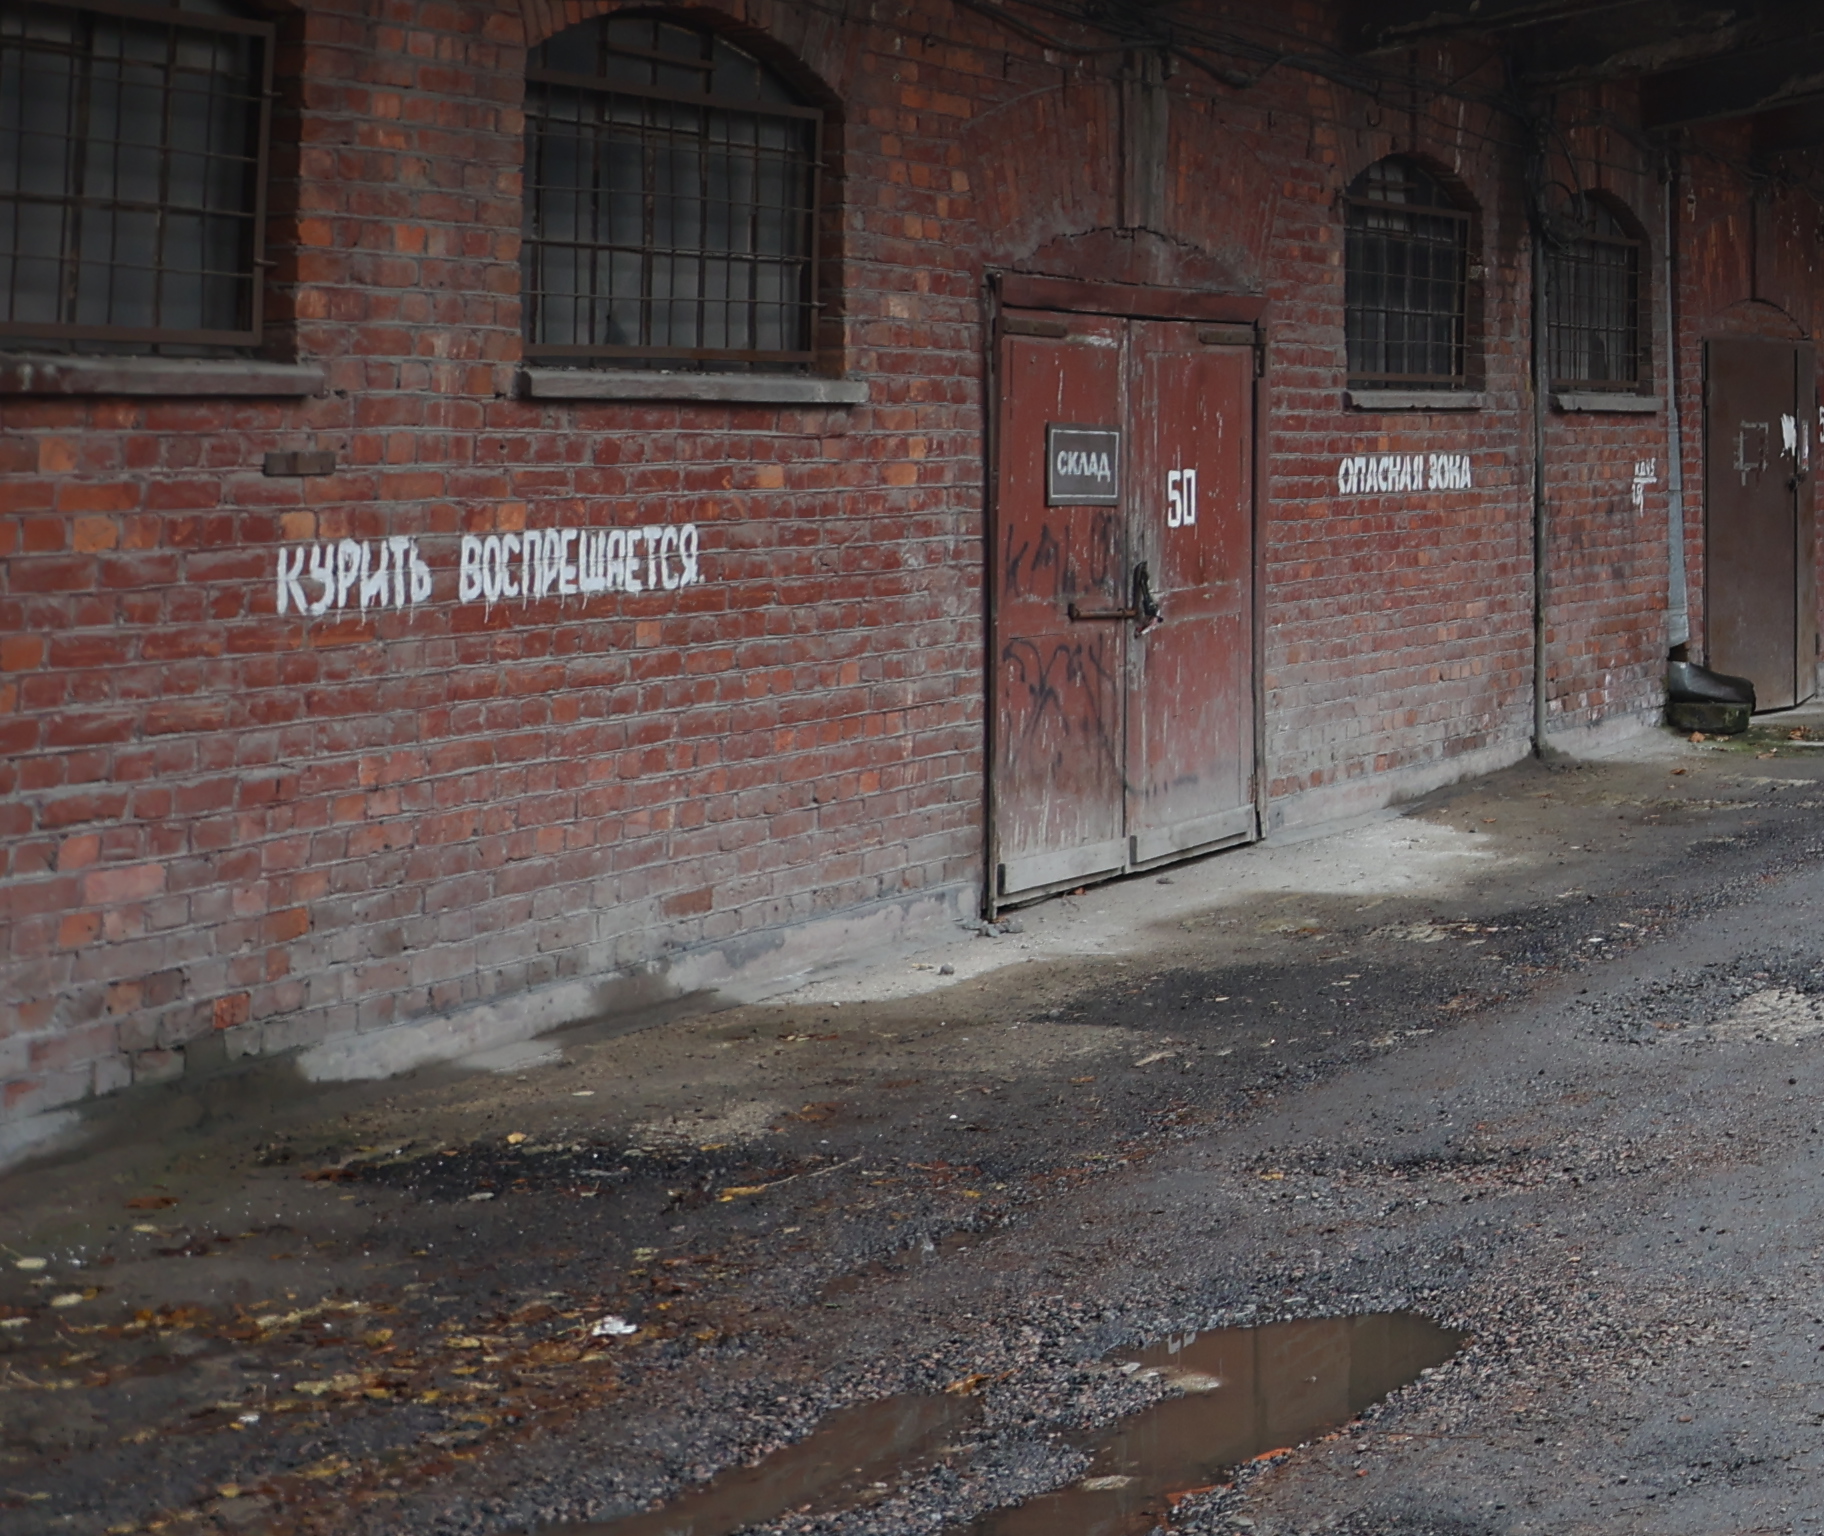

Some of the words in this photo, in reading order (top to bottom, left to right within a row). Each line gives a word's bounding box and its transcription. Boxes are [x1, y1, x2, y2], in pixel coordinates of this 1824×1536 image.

[1056, 450, 1111, 483] СКЛАД
[1338, 454, 1424, 494] ОПАСНАЯ
[1428, 453, 1472, 491] ЗОНА
[1167, 468, 1197, 529] 50
[277, 535, 433, 619] КУРИТЬ
